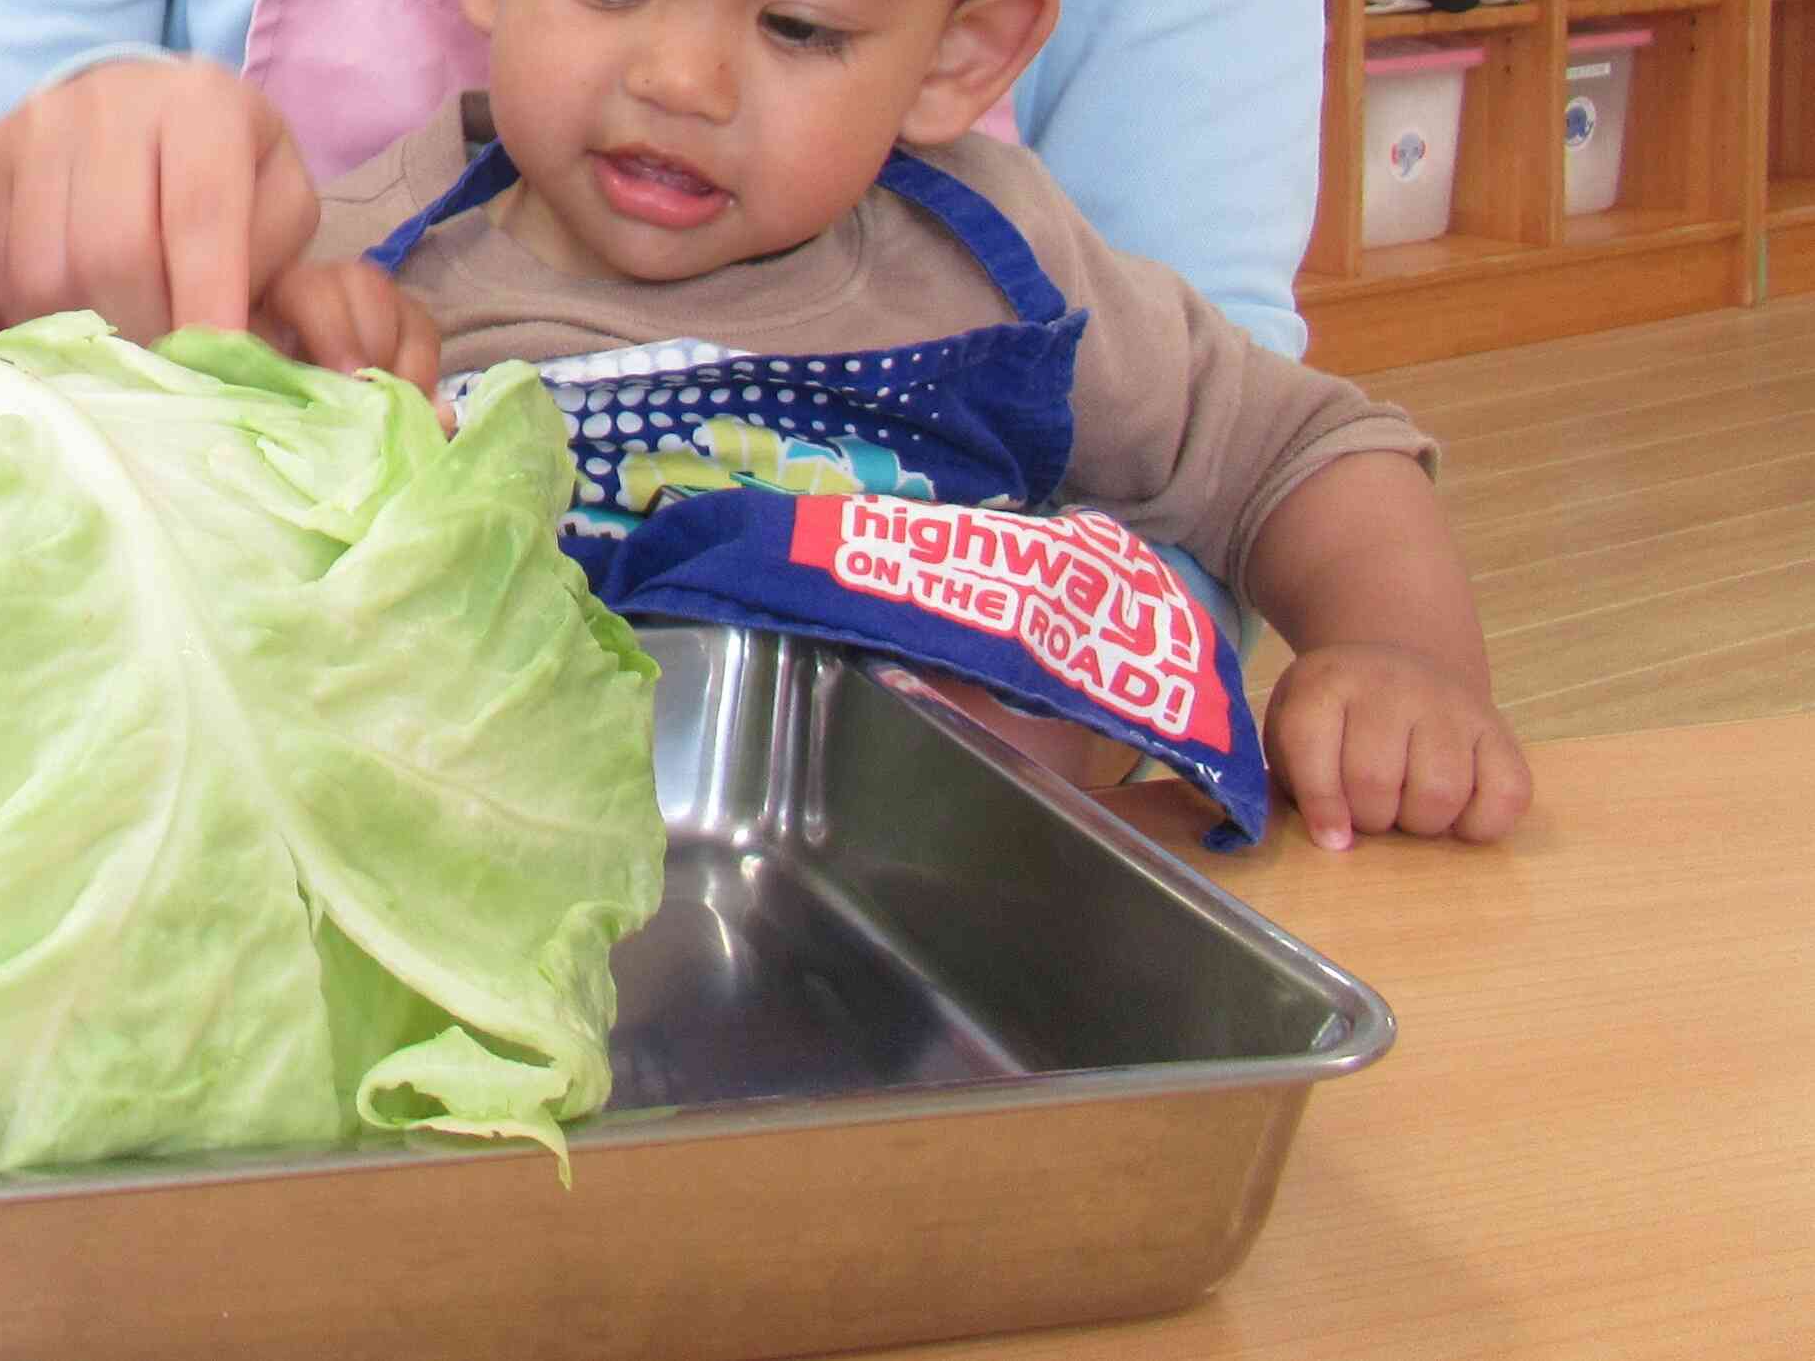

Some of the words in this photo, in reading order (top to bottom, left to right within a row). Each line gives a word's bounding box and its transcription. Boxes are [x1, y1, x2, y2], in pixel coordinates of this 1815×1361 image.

[846, 550, 901, 585] ON
[916, 570, 1008, 621] THE
[1028, 606, 1189, 723] ROAD!
[853, 505, 1194, 662] highway!
